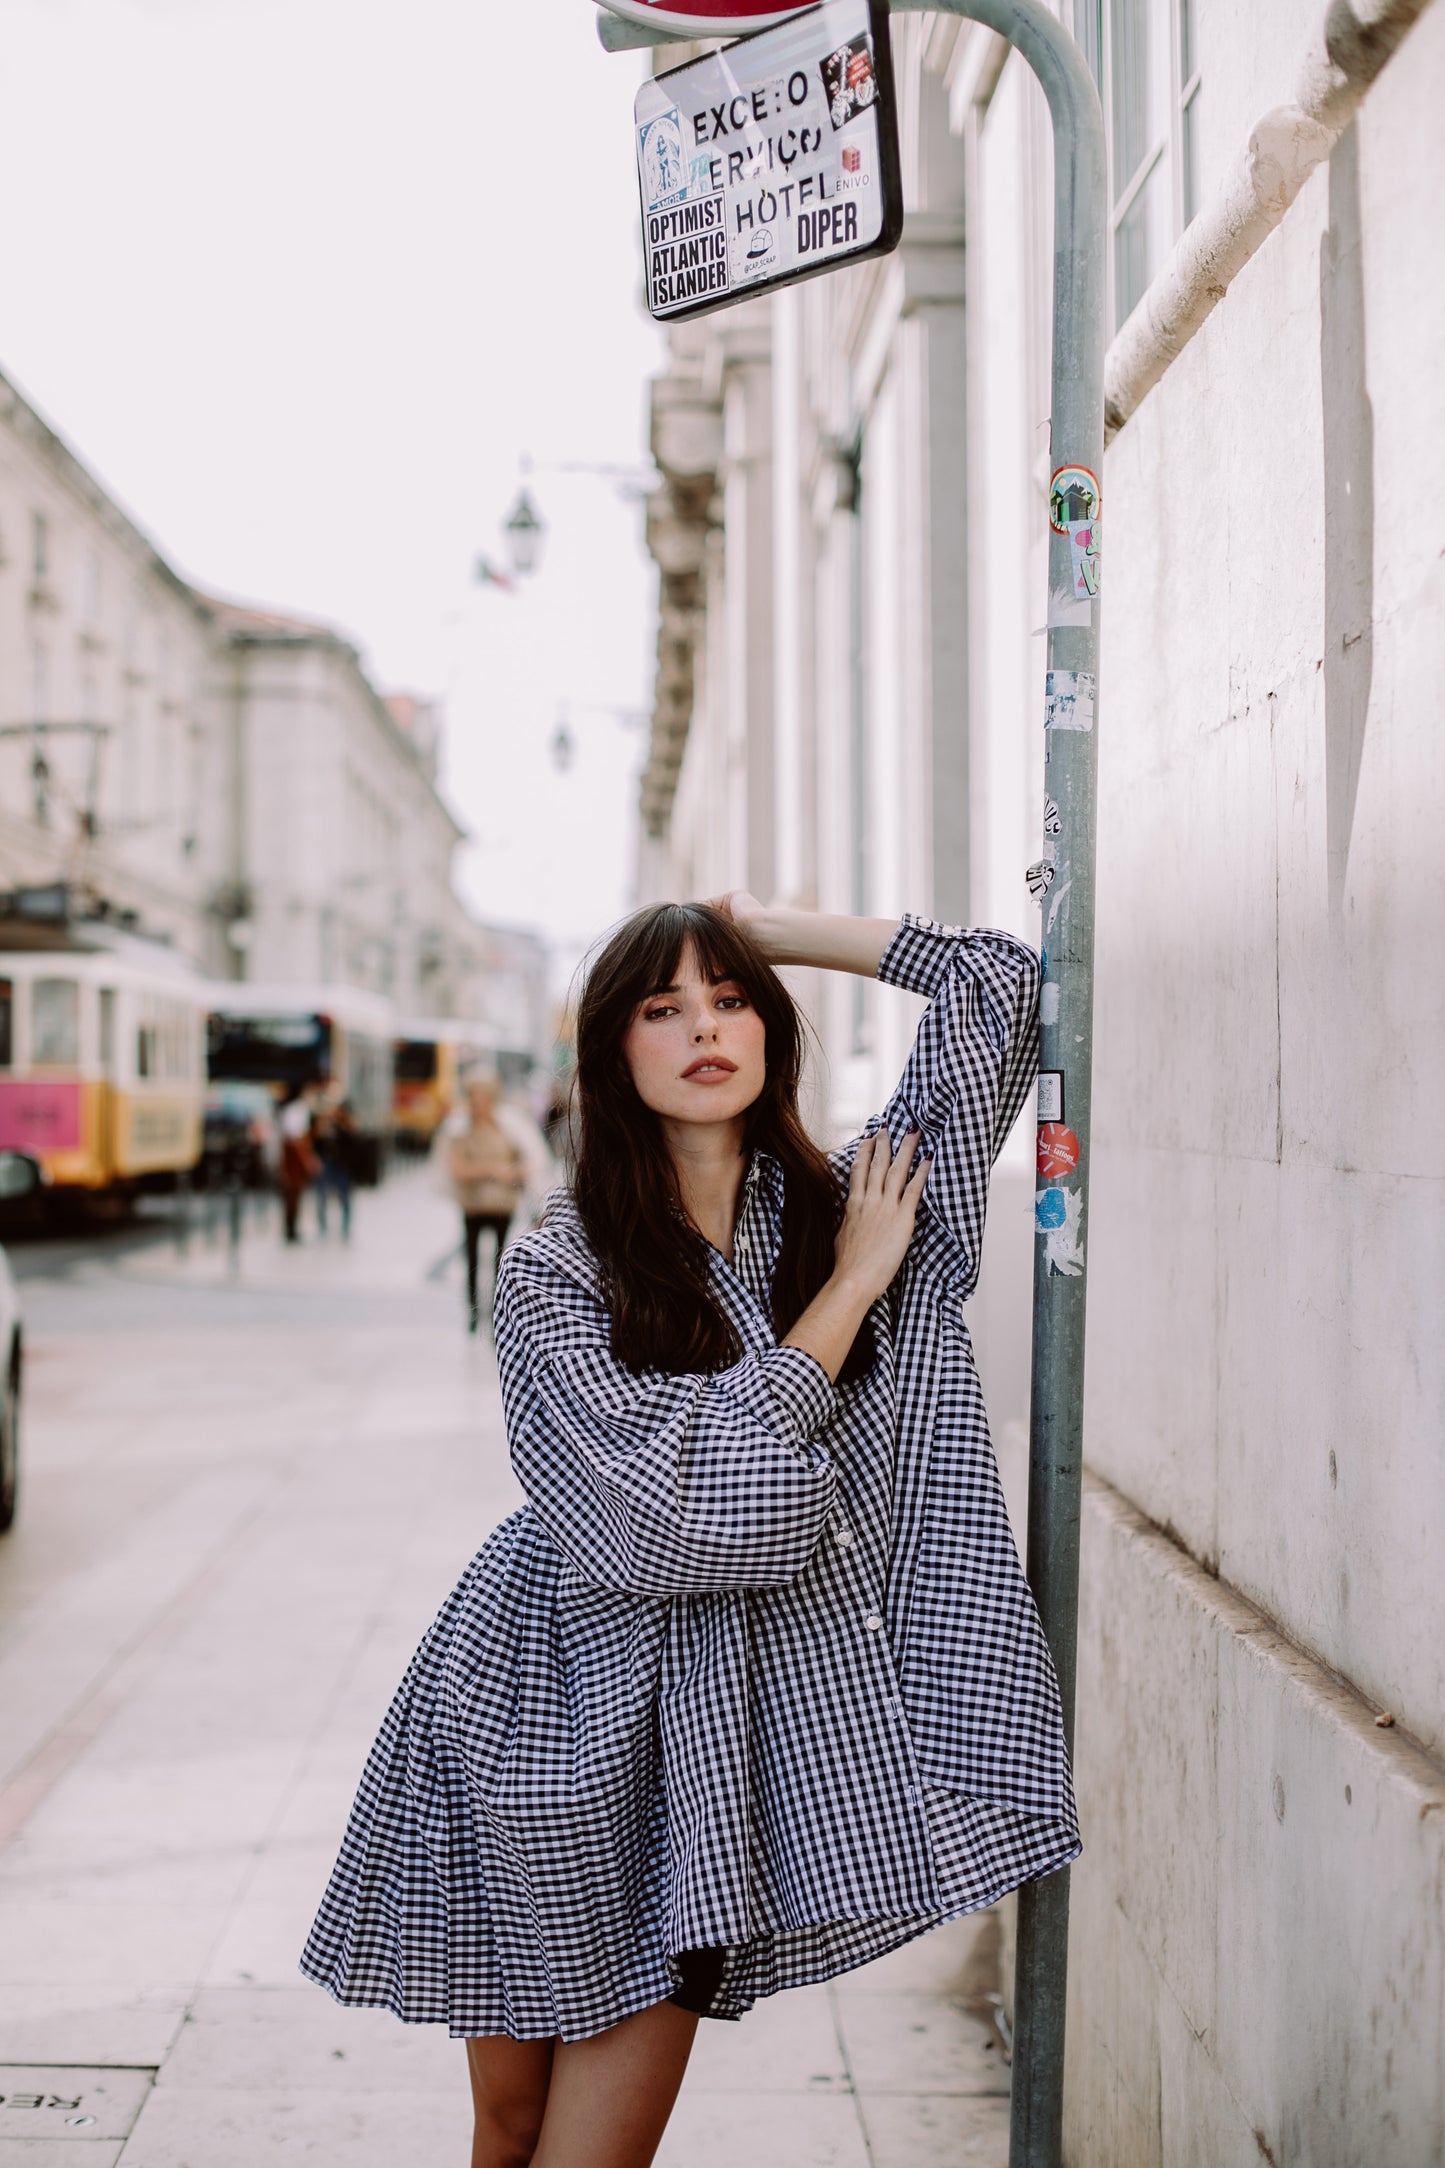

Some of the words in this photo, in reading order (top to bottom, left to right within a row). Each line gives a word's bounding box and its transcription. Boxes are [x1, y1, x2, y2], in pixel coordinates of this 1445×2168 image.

[709, 127, 821, 191] ERVIÇO
[650, 197, 723, 244] OPTIMIST
[798, 202, 857, 254] DIPER
[652, 231, 725, 278] ATLANTIC
[653, 260, 726, 306] ISLANDER
[0, 2094, 83, 2109] RE
